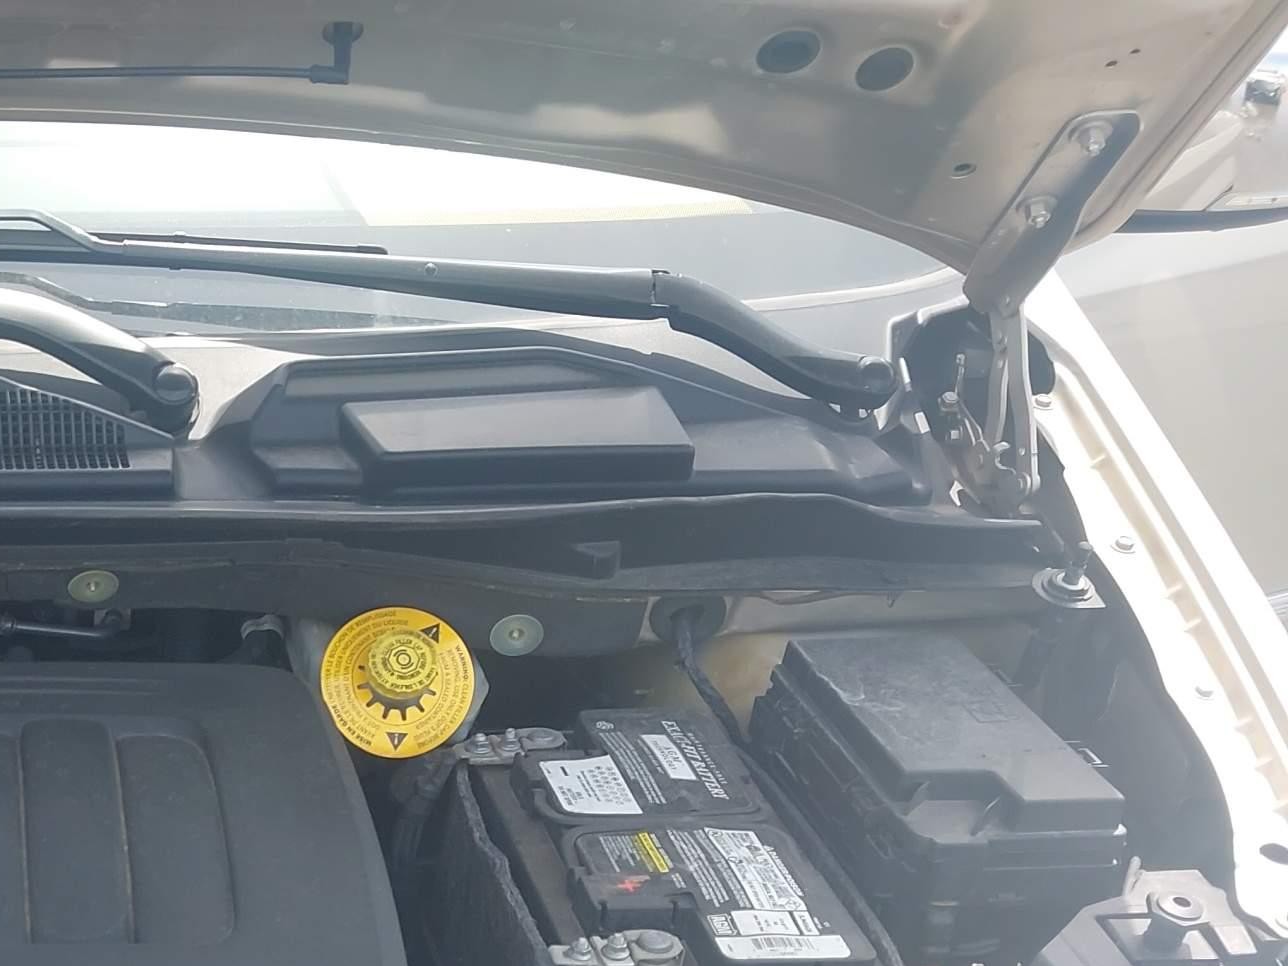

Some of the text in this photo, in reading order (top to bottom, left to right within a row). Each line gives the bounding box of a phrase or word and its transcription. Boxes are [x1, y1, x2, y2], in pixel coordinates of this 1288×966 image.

[459, 682, 468, 705] CLEAN
[330, 703, 348, 728] GARDE
[345, 725, 356, 736] EN
[690, 760, 730, 800] BATTERY
